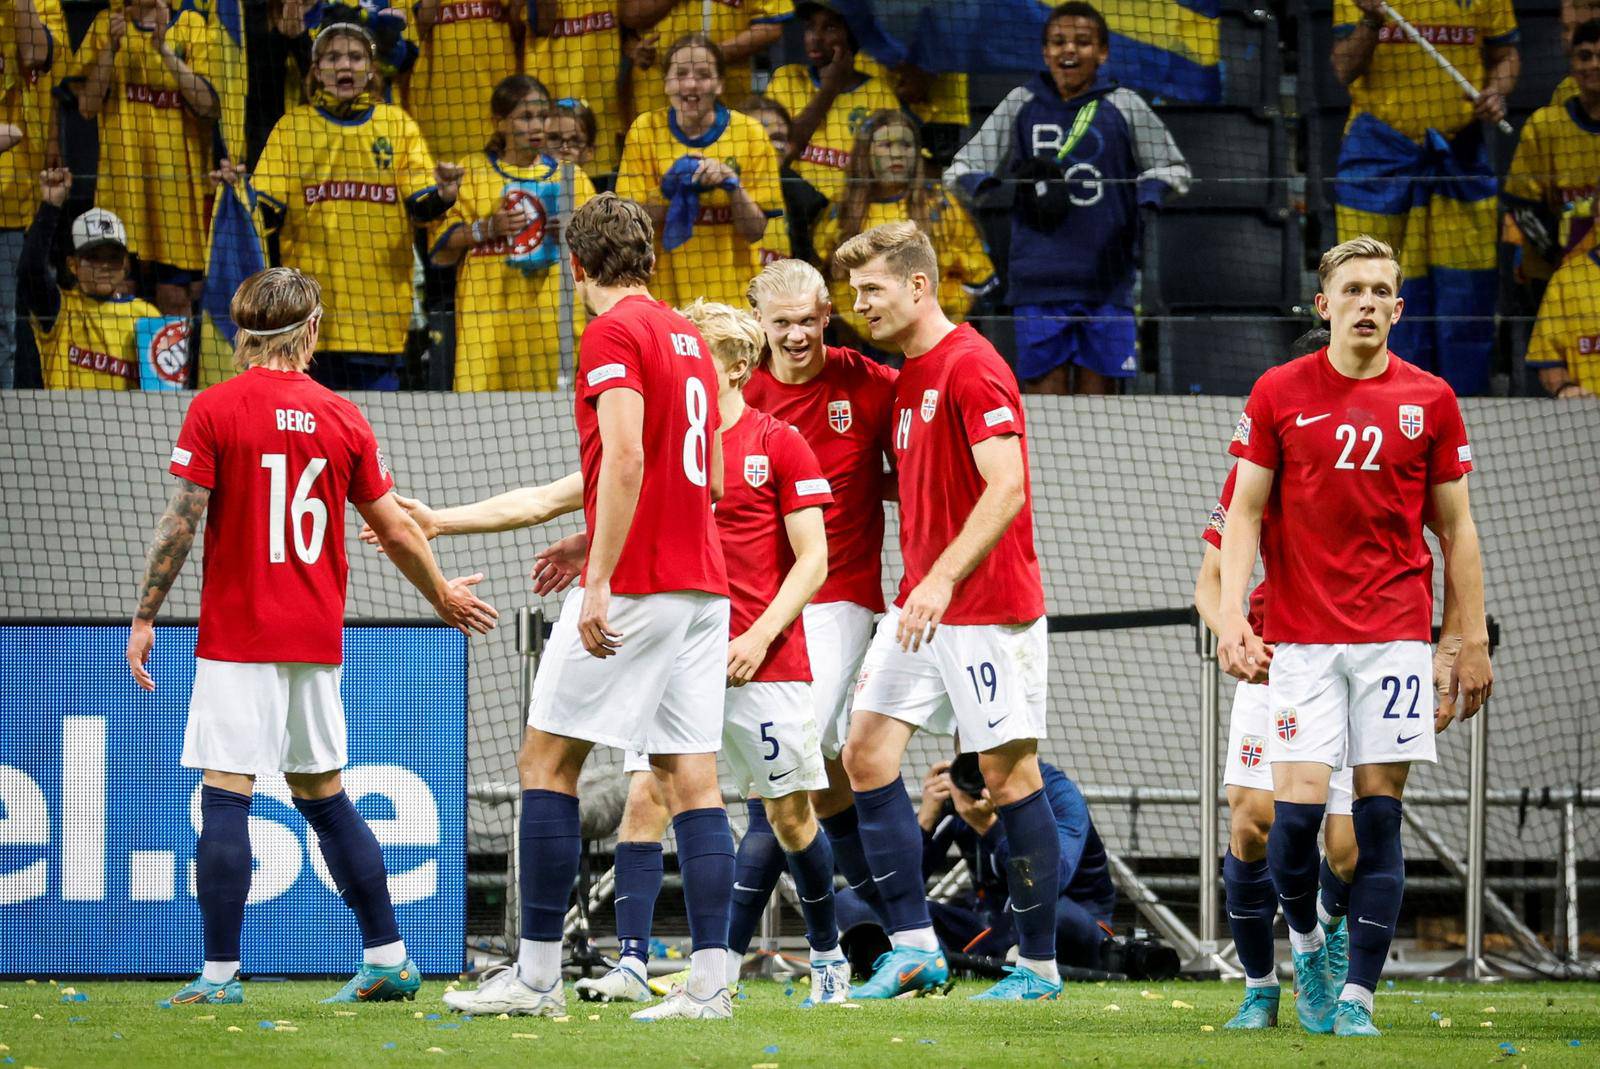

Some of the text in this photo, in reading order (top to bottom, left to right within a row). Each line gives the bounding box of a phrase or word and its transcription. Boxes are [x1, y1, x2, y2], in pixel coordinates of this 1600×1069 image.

[1379, 26, 1476, 43] BAHAUS
[305, 182, 396, 203] BAUHAUS
[276, 409, 316, 434] BERG
[683, 377, 708, 487] 8
[897, 408, 912, 449] 19
[1335, 424, 1383, 471] 22
[261, 454, 328, 565] 16
[966, 663, 997, 703] 19
[1382, 675, 1420, 719] 22
[761, 722, 780, 761] 5
